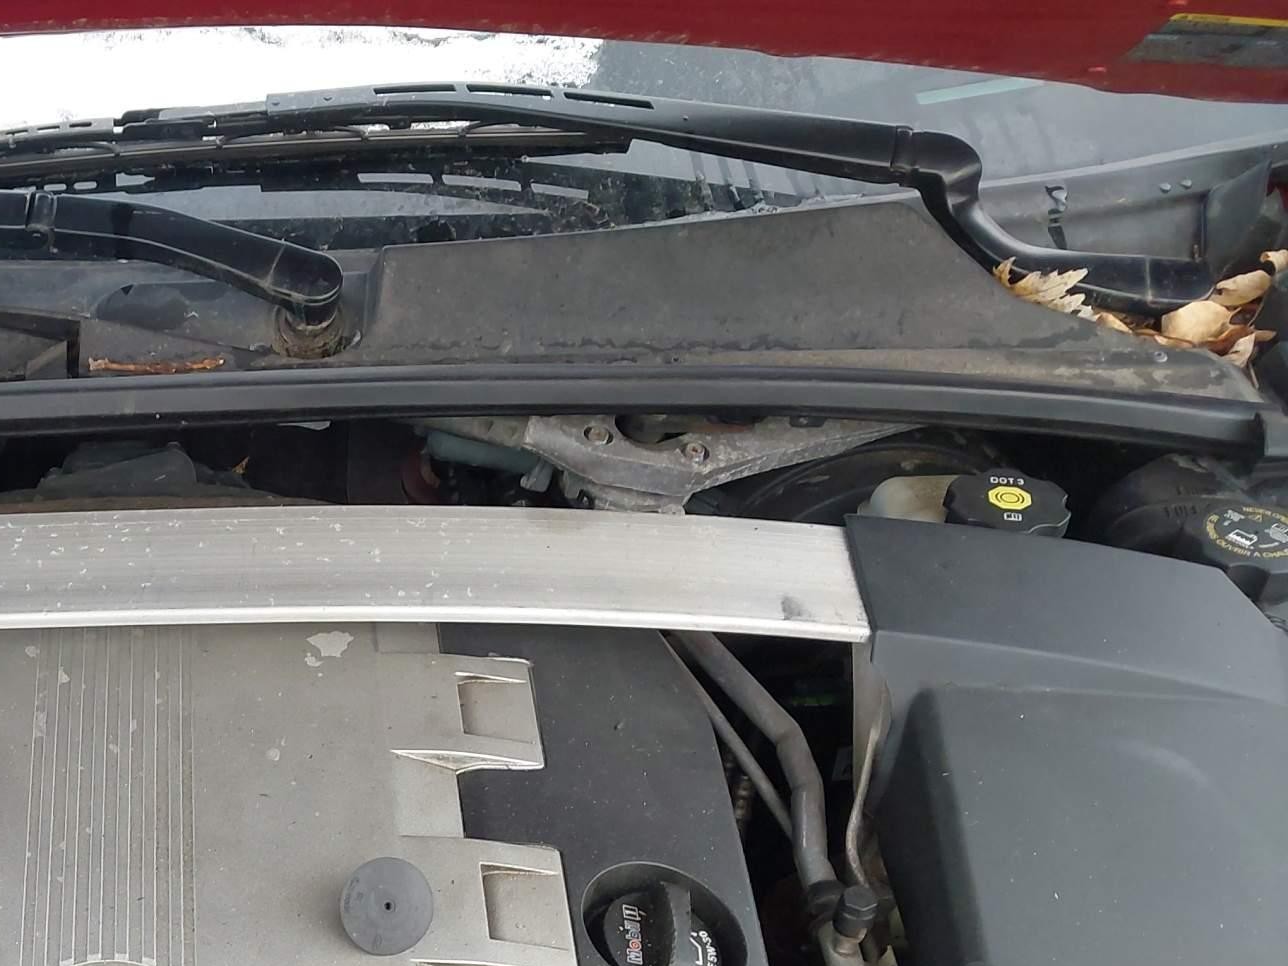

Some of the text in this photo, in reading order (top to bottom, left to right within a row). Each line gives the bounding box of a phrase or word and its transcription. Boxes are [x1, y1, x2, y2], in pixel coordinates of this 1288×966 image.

[989, 476, 1025, 486] DOT 3
[624, 920, 643, 965] Mobil
[698, 930, 718, 962] 5W-30
